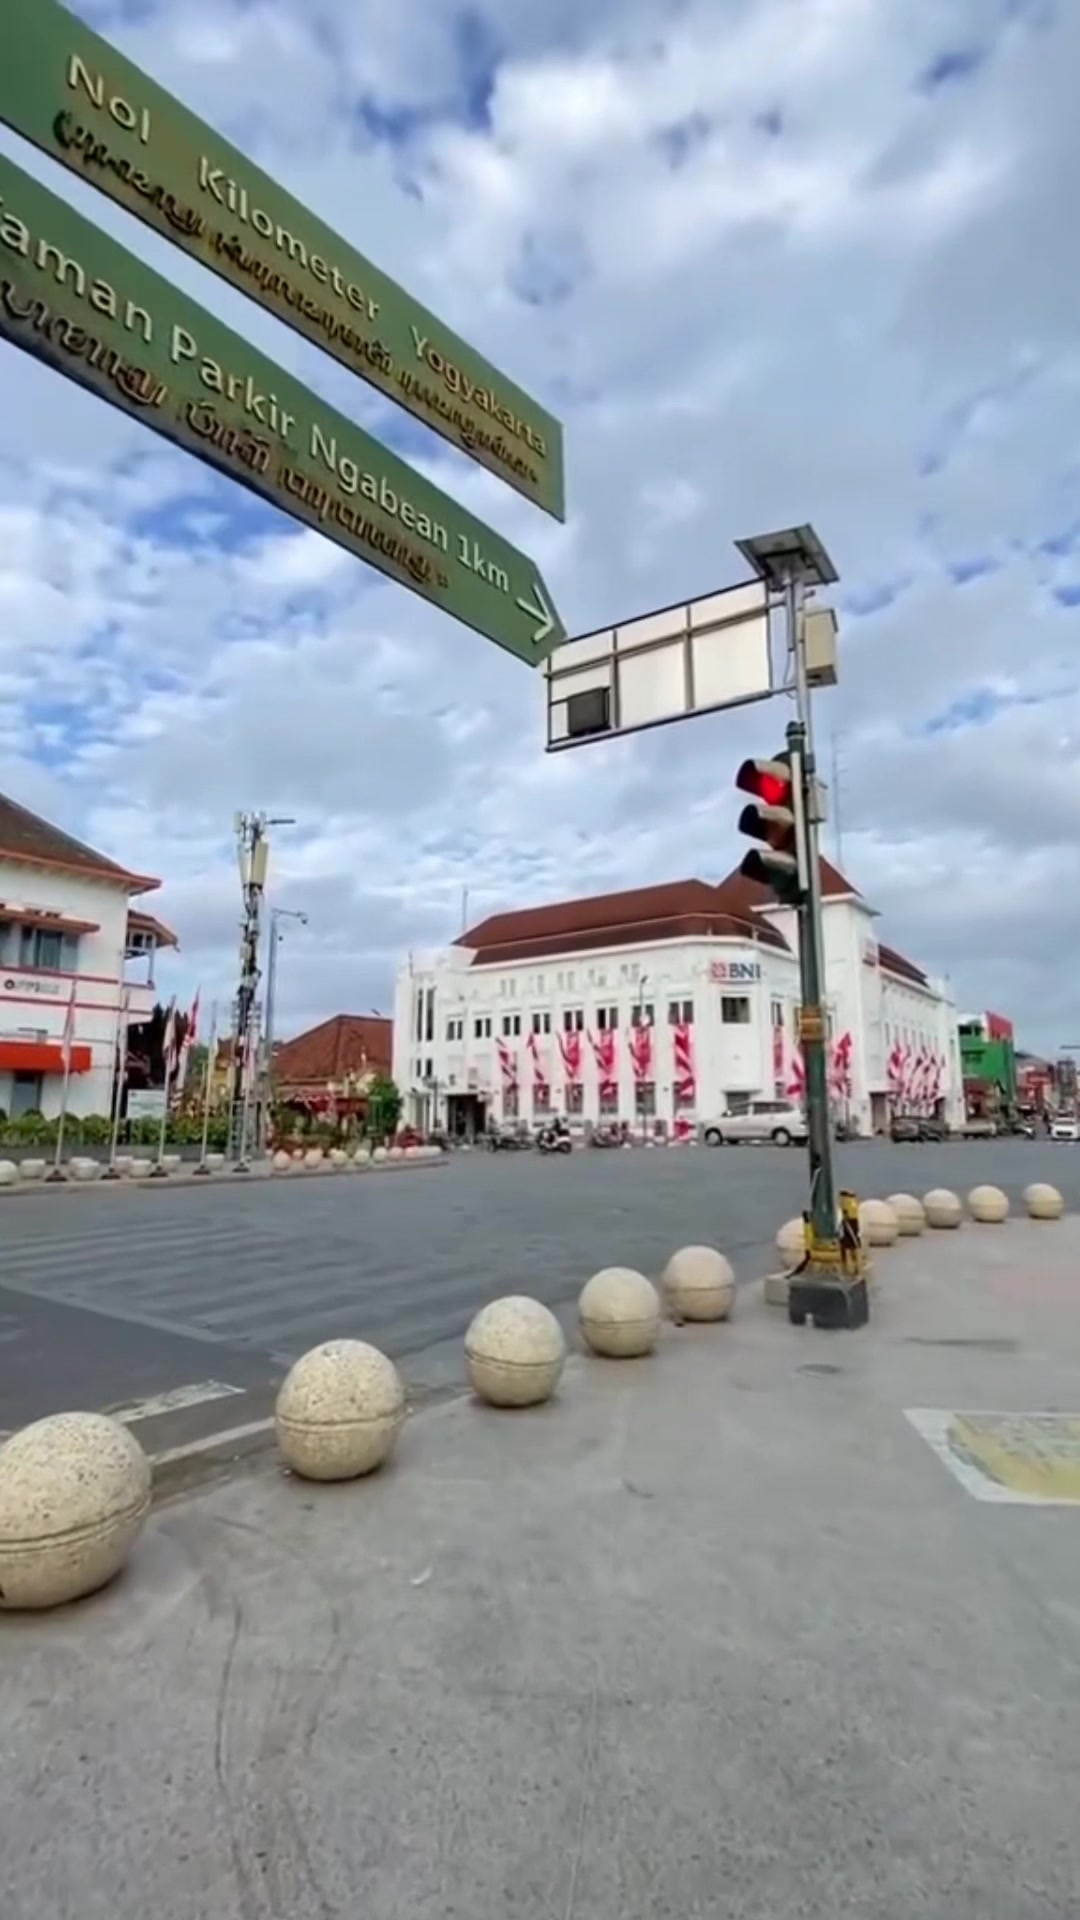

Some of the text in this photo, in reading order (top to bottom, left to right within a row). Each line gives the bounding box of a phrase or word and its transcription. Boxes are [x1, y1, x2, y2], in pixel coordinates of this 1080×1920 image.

[0, 195, 510, 593] aman Parkir Ngabean 1km
[67, 53, 547, 458] Nol Kilometer Yogyakarta
[728, 961, 761, 979] BNI
